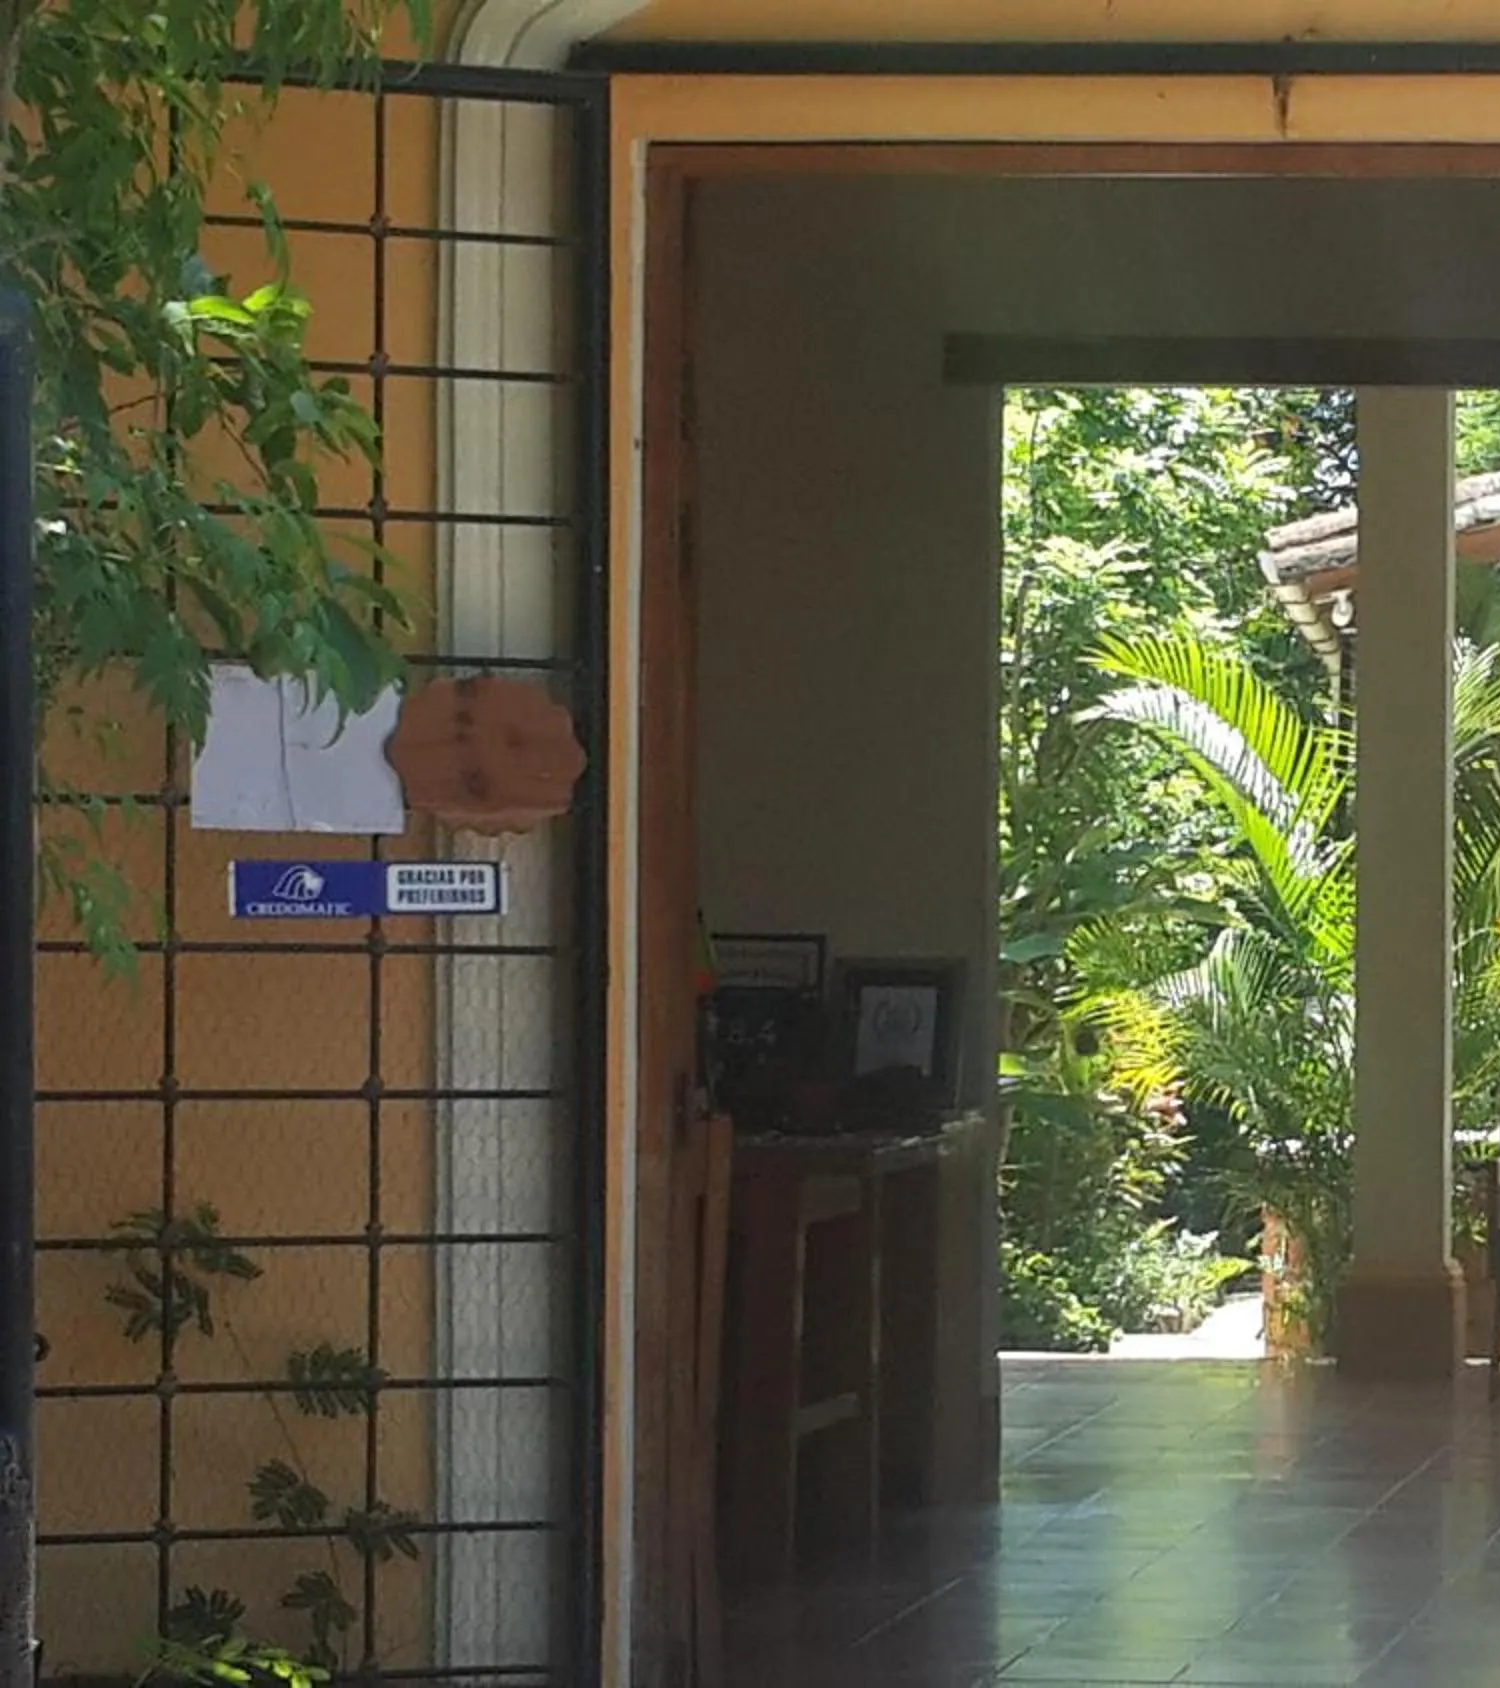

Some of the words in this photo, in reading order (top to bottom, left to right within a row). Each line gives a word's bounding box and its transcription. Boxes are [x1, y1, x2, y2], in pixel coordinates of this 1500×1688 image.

[397, 869, 453, 886] GRACIAS
[459, 869, 486, 886] POR
[246, 902, 351, 916] CREDOMATIC
